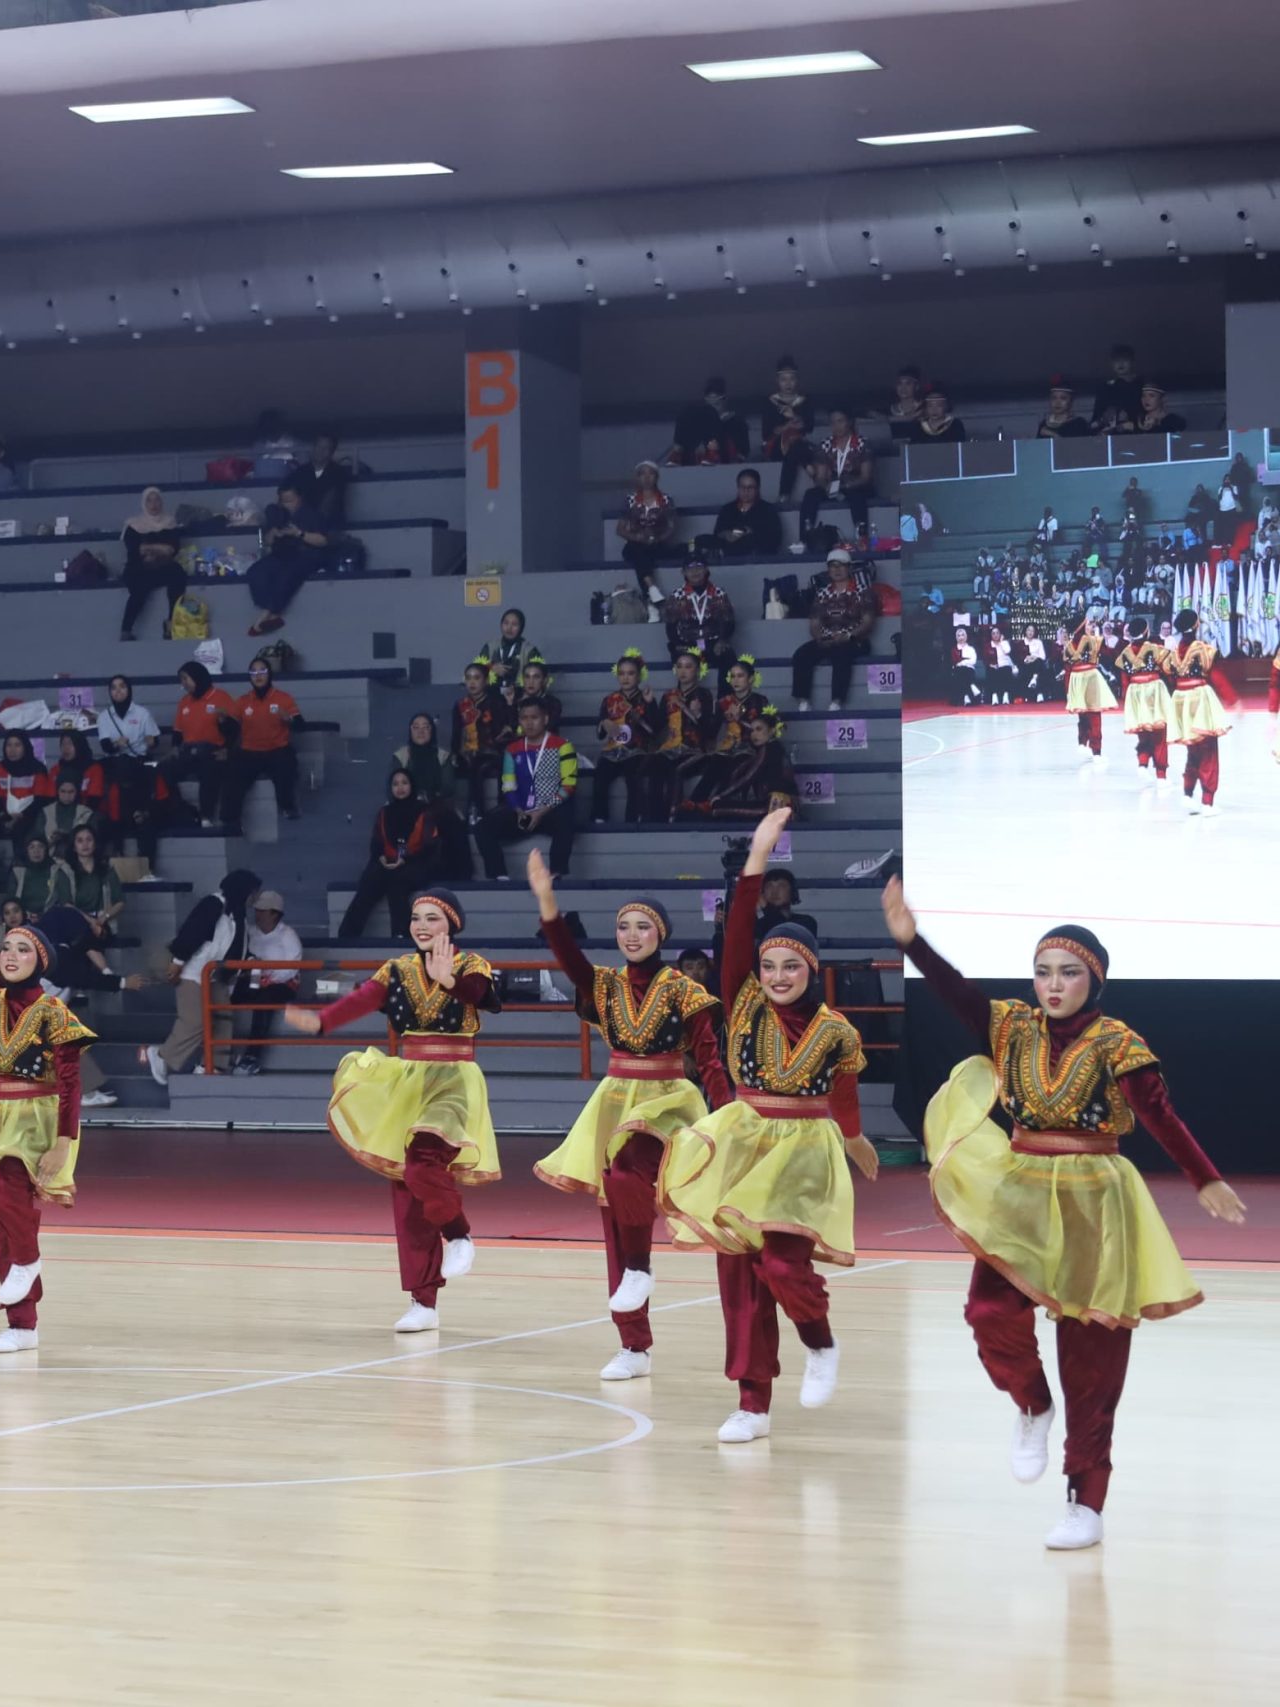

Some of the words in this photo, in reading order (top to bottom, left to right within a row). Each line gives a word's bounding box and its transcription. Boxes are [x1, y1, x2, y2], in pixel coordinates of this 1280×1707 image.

[879, 671, 895, 685] 30
[69, 694, 81, 708] 31
[838, 726, 855, 741] 29
[805, 781, 822, 796] 28
